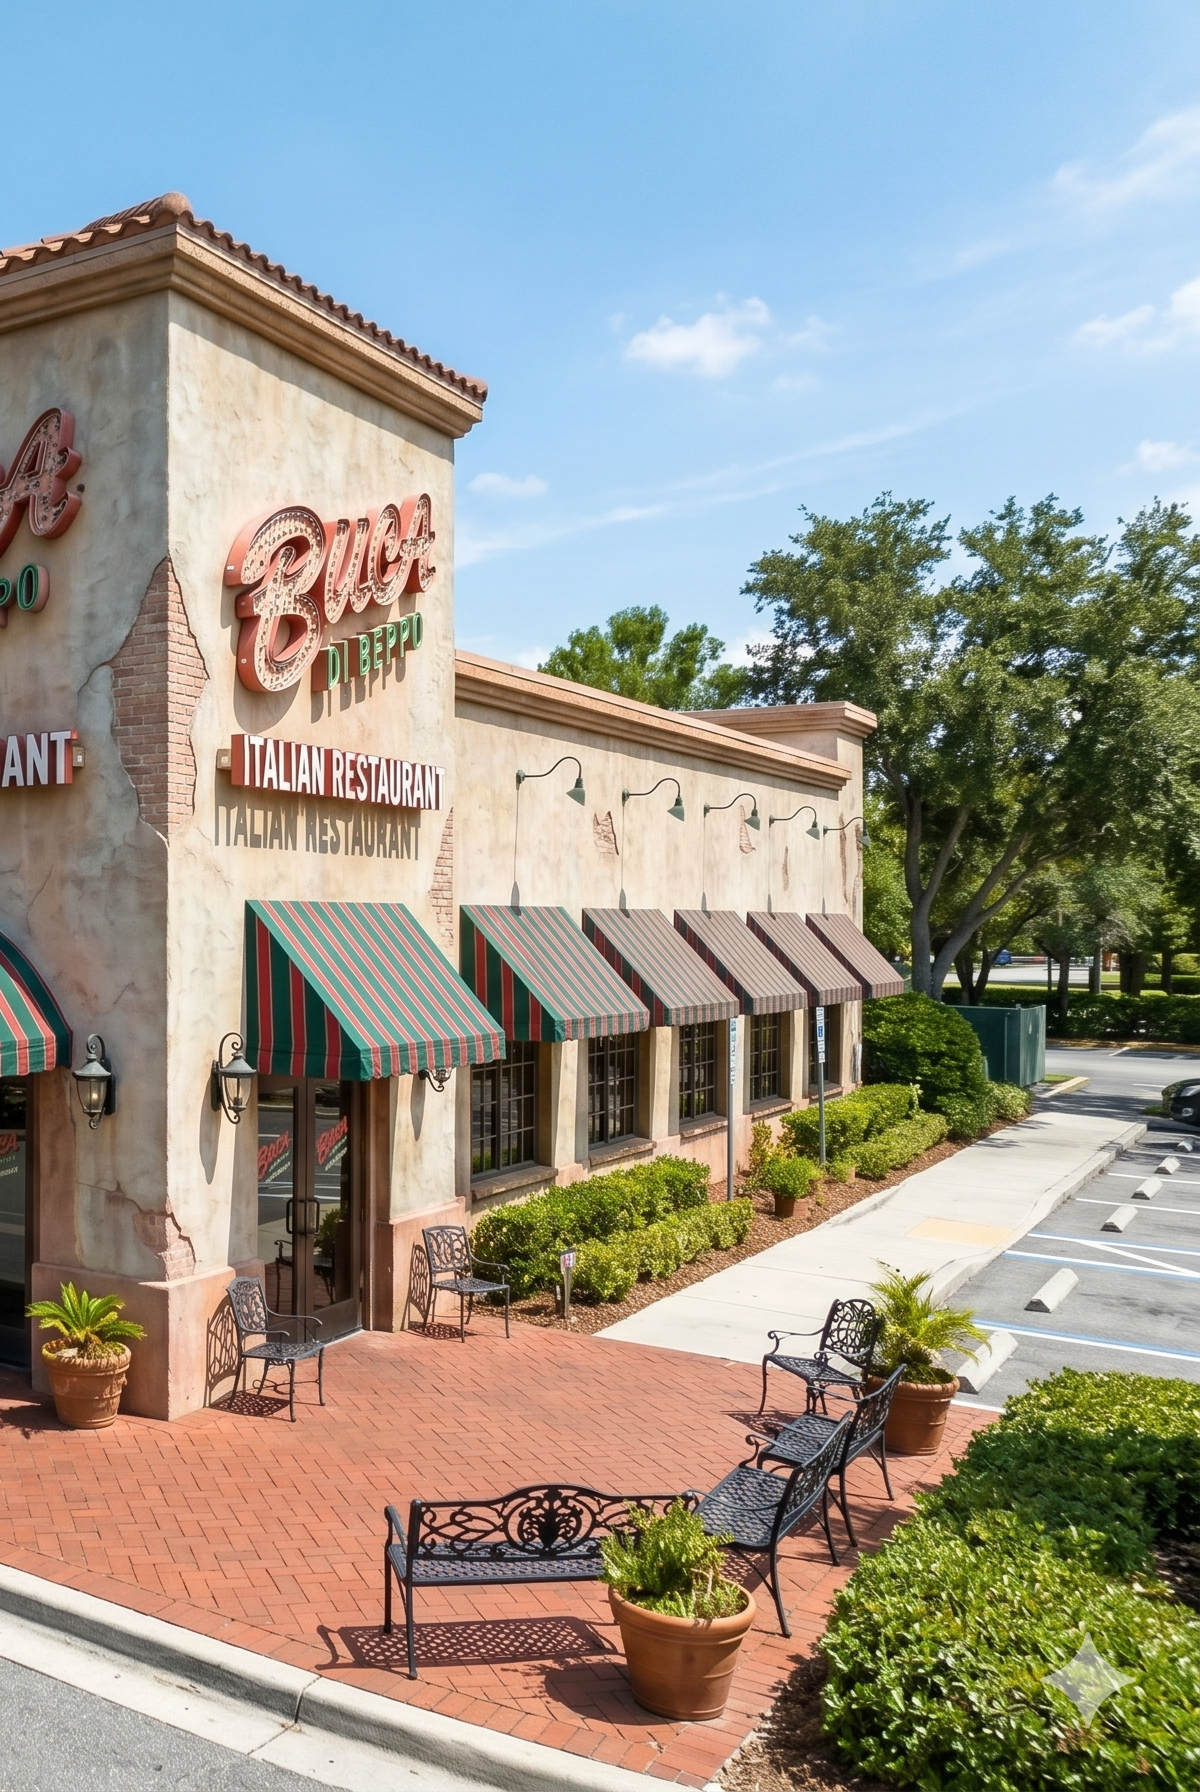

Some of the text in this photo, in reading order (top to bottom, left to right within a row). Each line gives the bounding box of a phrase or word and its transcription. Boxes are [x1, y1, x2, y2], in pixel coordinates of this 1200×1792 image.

[224, 493, 436, 692] BUCA
[326, 612, 424, 690] DI BEPPO
[243, 734, 445, 811] ITALIAN RESTAURANT
